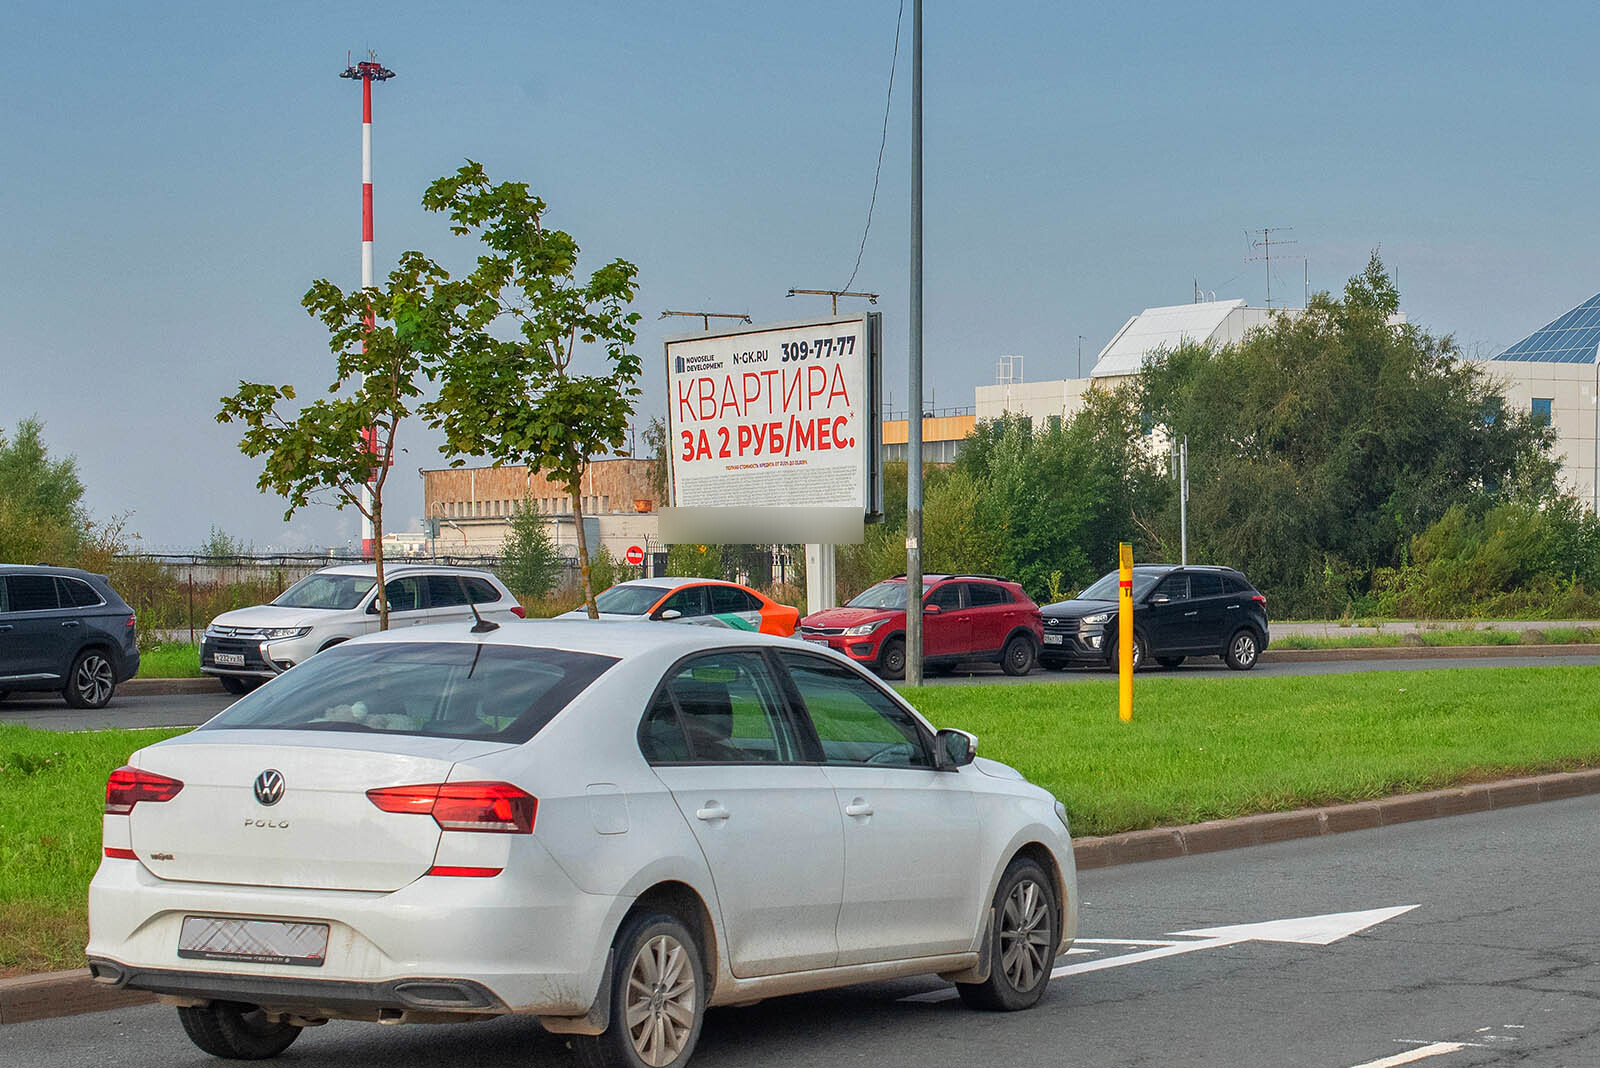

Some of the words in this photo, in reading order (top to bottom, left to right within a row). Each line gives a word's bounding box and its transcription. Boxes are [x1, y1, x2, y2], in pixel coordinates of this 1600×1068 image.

[781, 336, 856, 363] 309-77-77
[686, 361, 724, 372] DEVELOPMENT
[678, 362, 850, 423] КВАРТИРА
[681, 428, 712, 462] ЗА
[717, 426, 732, 459] 2
[244, 818, 290, 829] POLO
